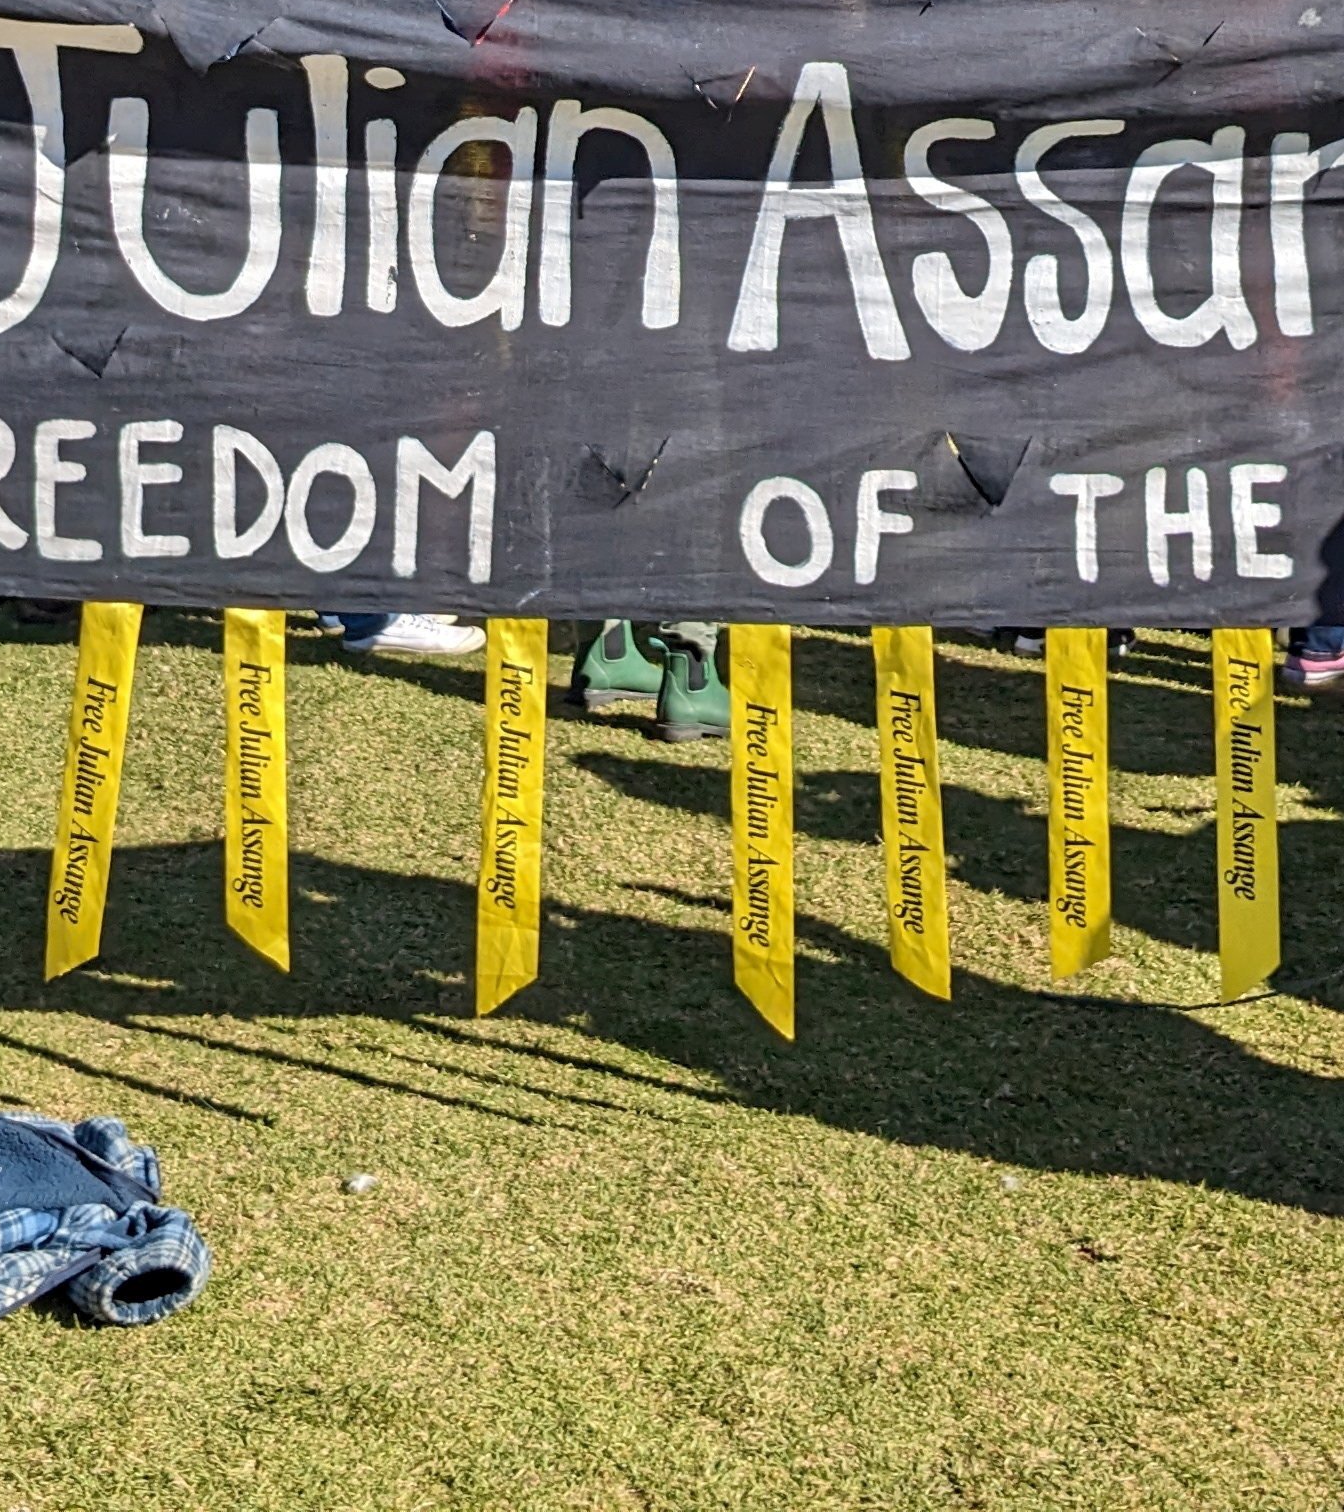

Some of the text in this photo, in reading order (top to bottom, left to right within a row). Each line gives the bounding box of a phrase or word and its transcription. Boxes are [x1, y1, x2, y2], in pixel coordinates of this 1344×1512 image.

[739, 468, 918, 587] OF
[1049, 463, 1294, 586] THE
[56, 676, 117, 924] Free Julian Assange
[233, 662, 272, 909] Free Julian Assange
[486, 661, 532, 910] Free Julian Assange
[740, 703, 779, 948] Free Julian Assange
[890, 690, 929, 934] Free Julian Assange
[1057, 685, 1094, 929] Free Julian Assange
[1225, 658, 1264, 900] Free Julian Assange
